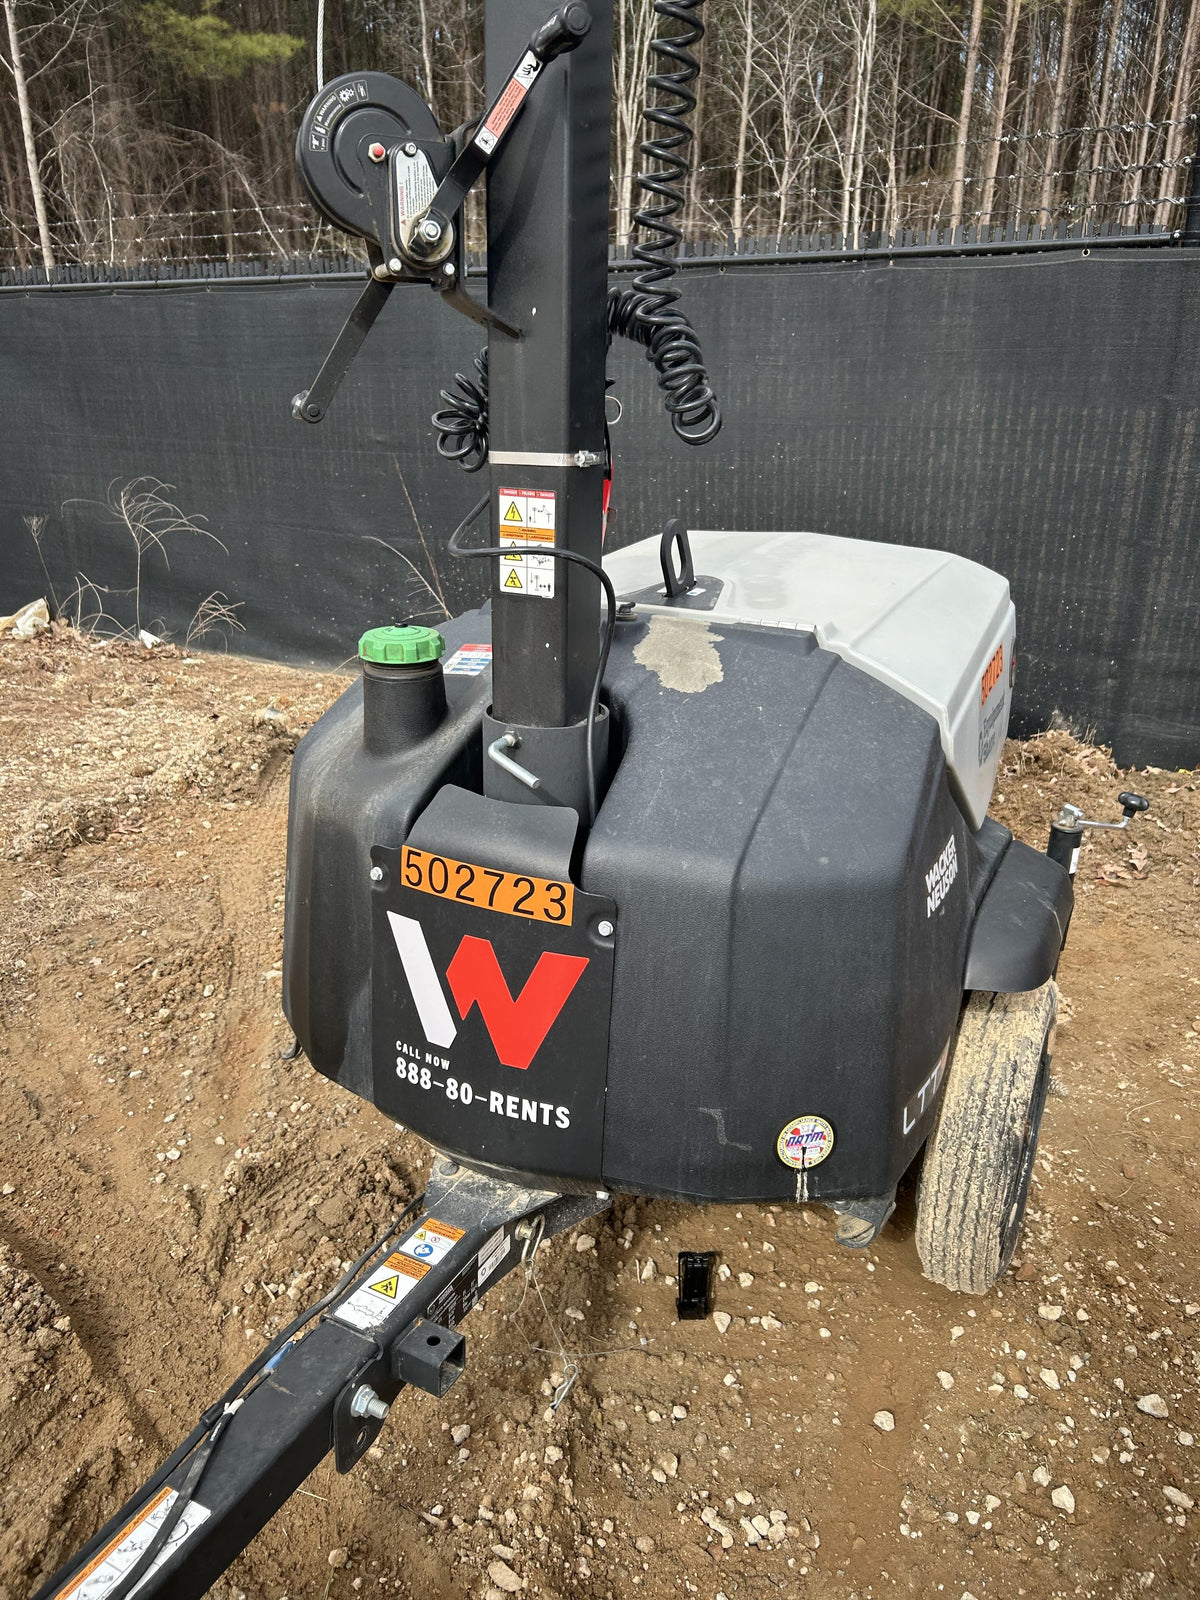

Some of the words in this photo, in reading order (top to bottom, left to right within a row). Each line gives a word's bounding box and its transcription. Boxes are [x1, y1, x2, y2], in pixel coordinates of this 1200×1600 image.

[405, 850, 568, 922] 502723
[925, 834, 957, 894] WACKER
[927, 853, 958, 918] NEUSON
[395, 1040, 421, 1060] CALL
[425, 1053, 451, 1071] NOW
[395, 1057, 571, 1129] 888-80-RENTS
